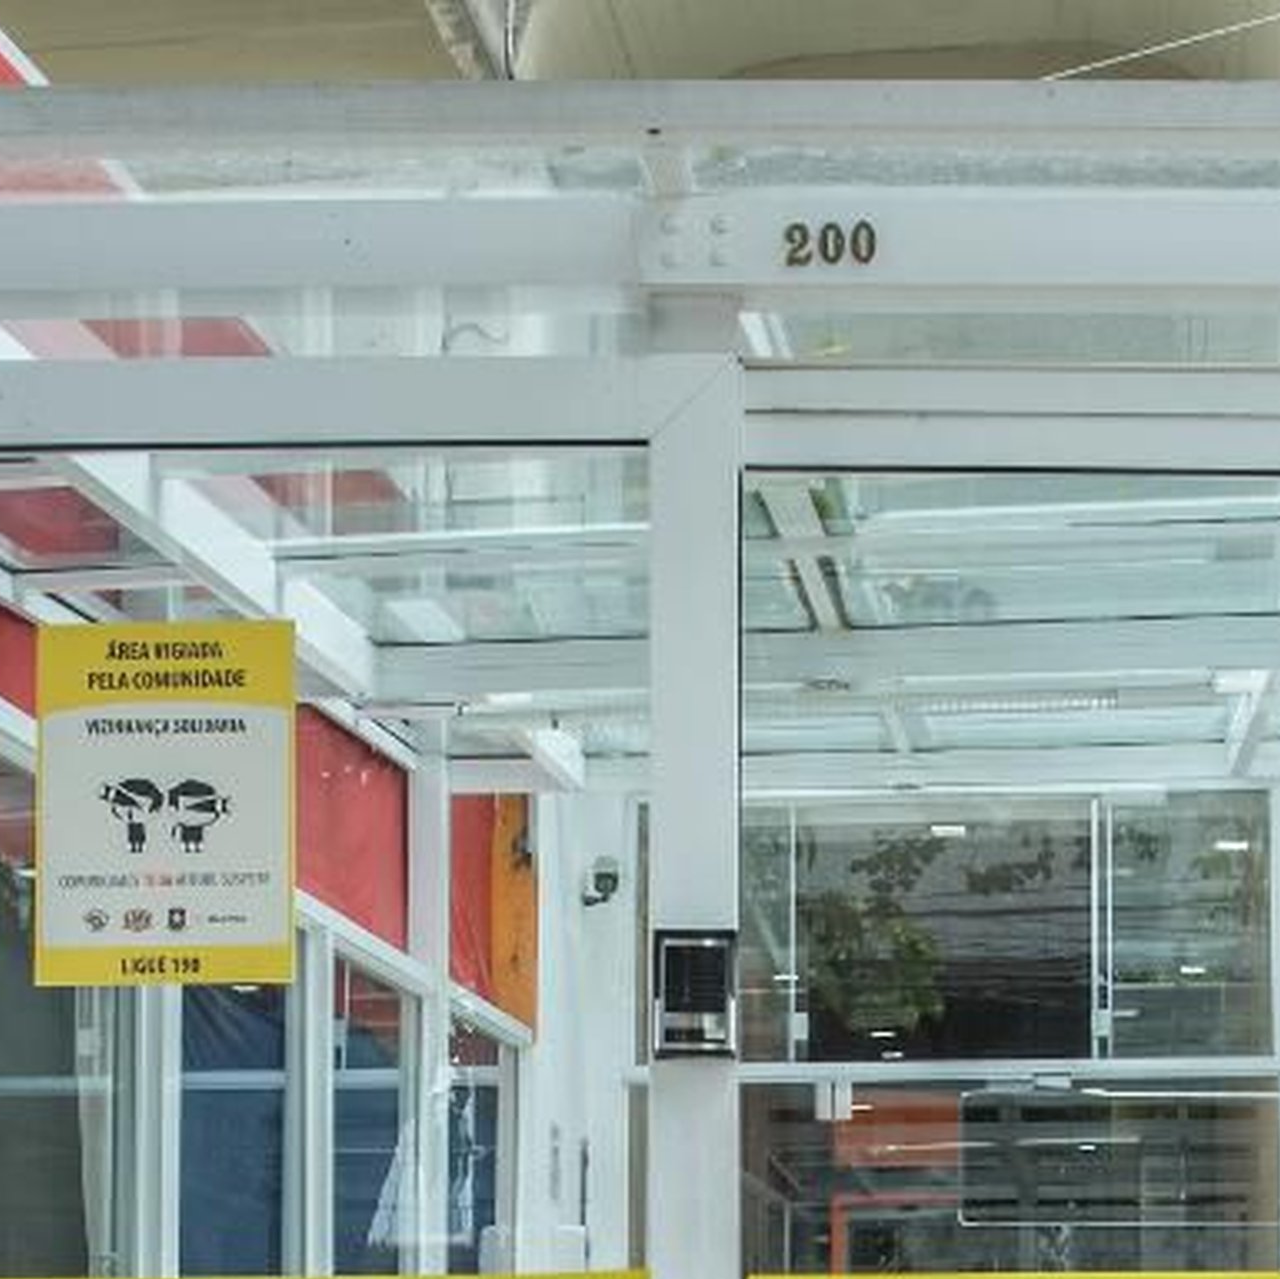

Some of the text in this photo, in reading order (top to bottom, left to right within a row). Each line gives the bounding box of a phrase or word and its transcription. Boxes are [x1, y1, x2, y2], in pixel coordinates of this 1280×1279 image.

[784, 219, 876, 267] 200
[106, 639, 150, 660] ÁREA
[87, 669, 246, 690] PELA COMUNIDADE
[121, 957, 202, 976] LIGUE 190
